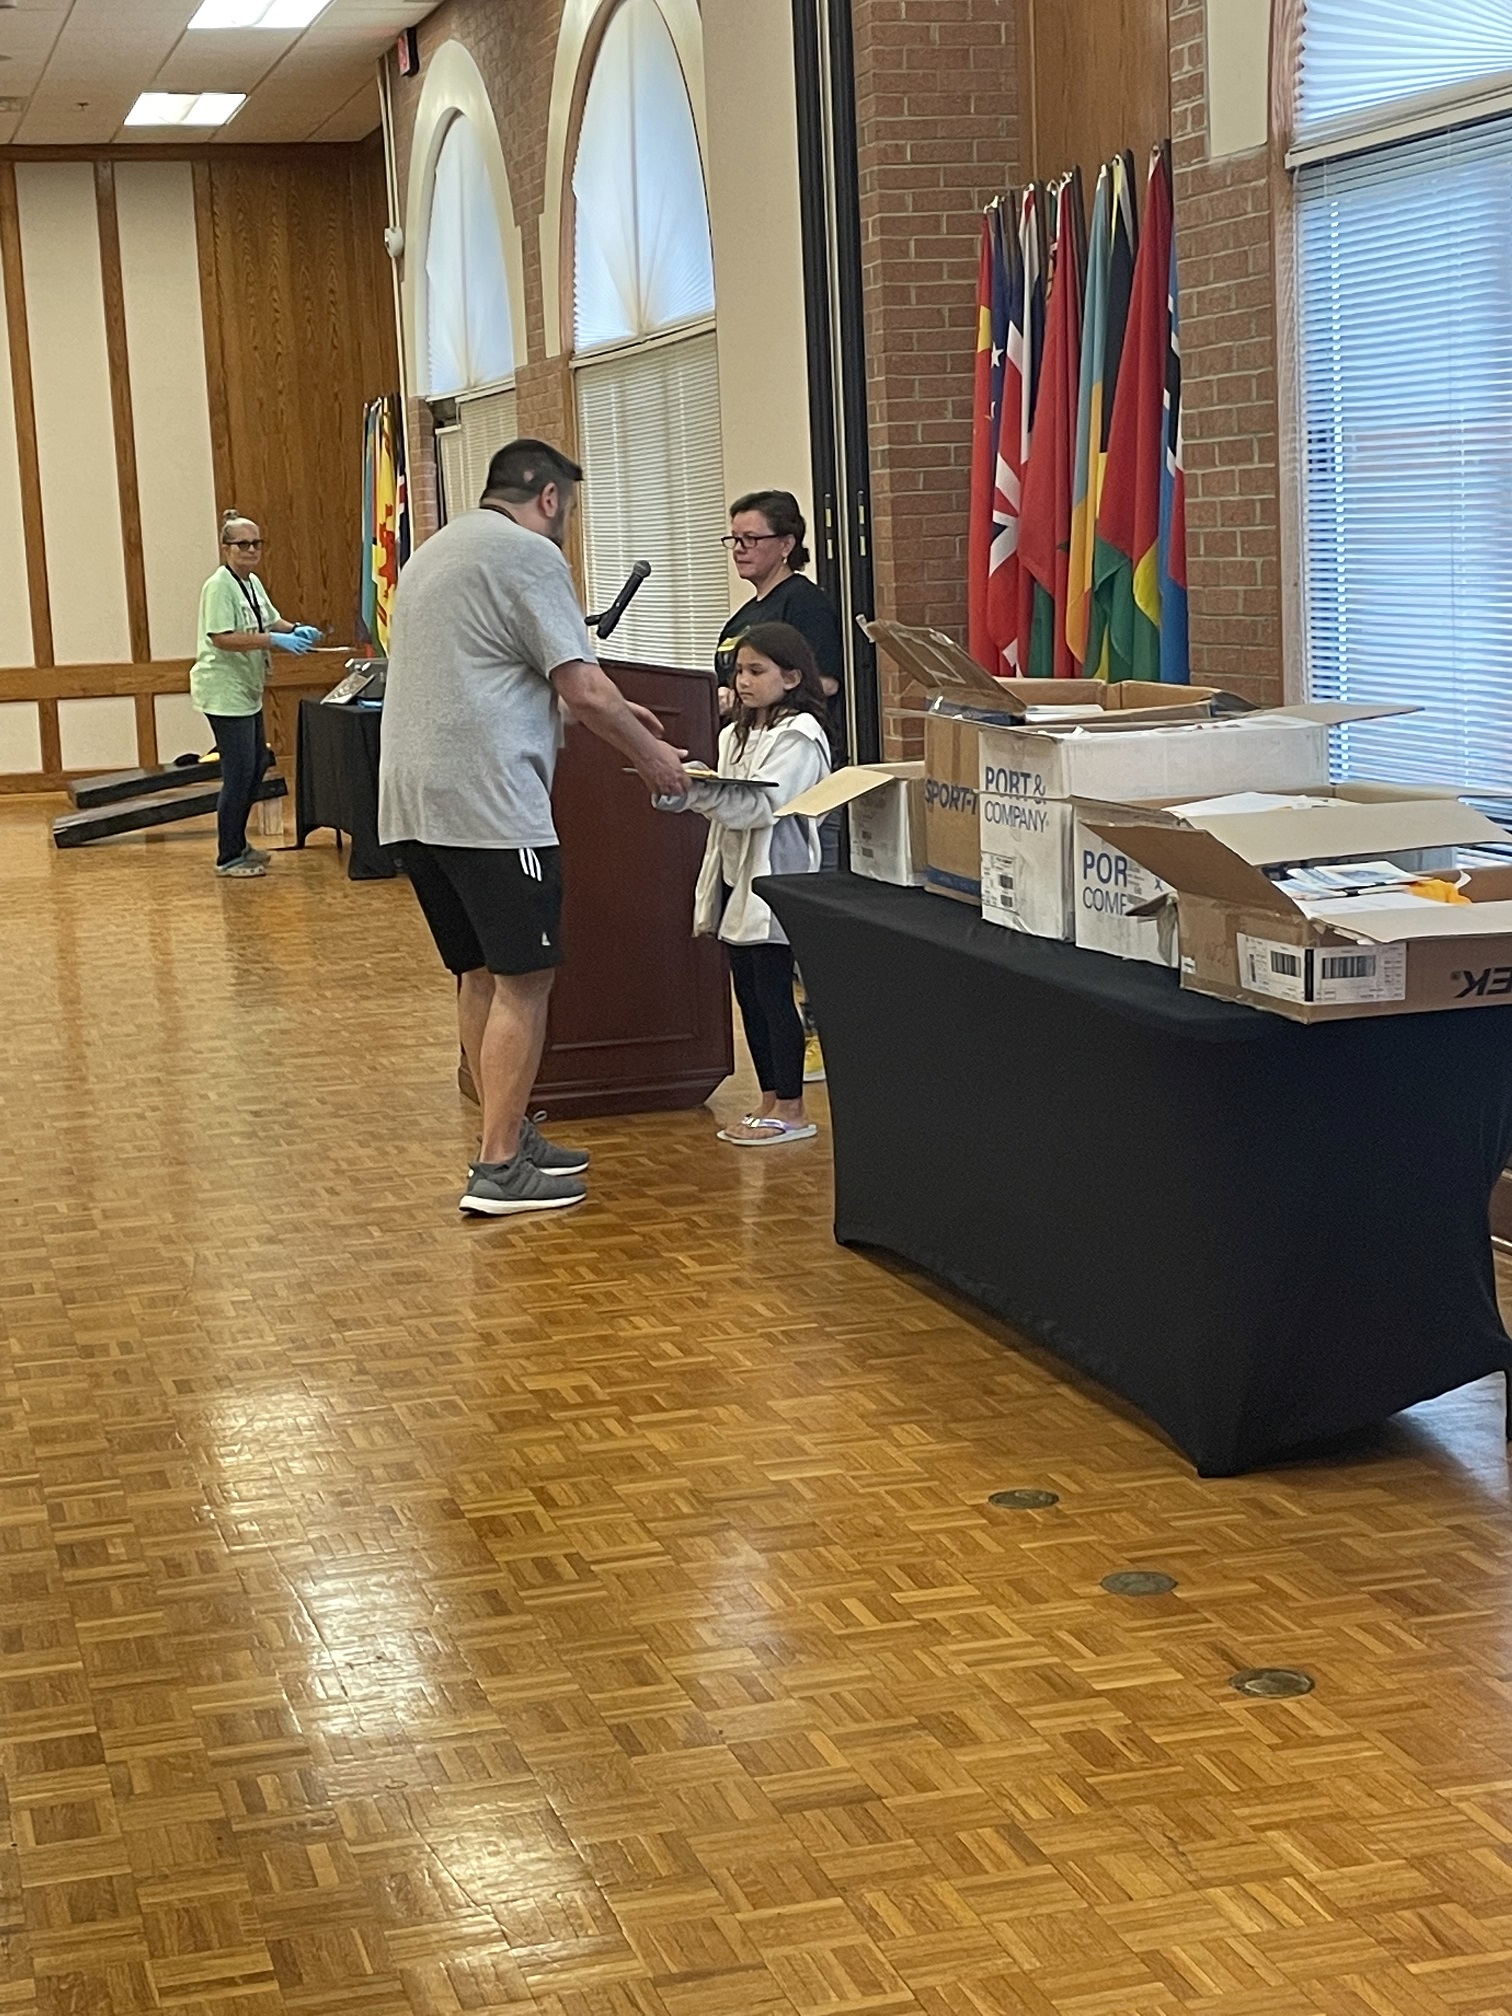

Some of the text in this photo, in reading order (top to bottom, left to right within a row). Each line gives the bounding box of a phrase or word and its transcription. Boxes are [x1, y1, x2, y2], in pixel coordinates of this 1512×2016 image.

[985, 766, 1047, 804] PORT &
[984, 800, 1048, 833] COMPANY
[1083, 850, 1128, 887] POR
[1083, 886, 1128, 916] COMP
